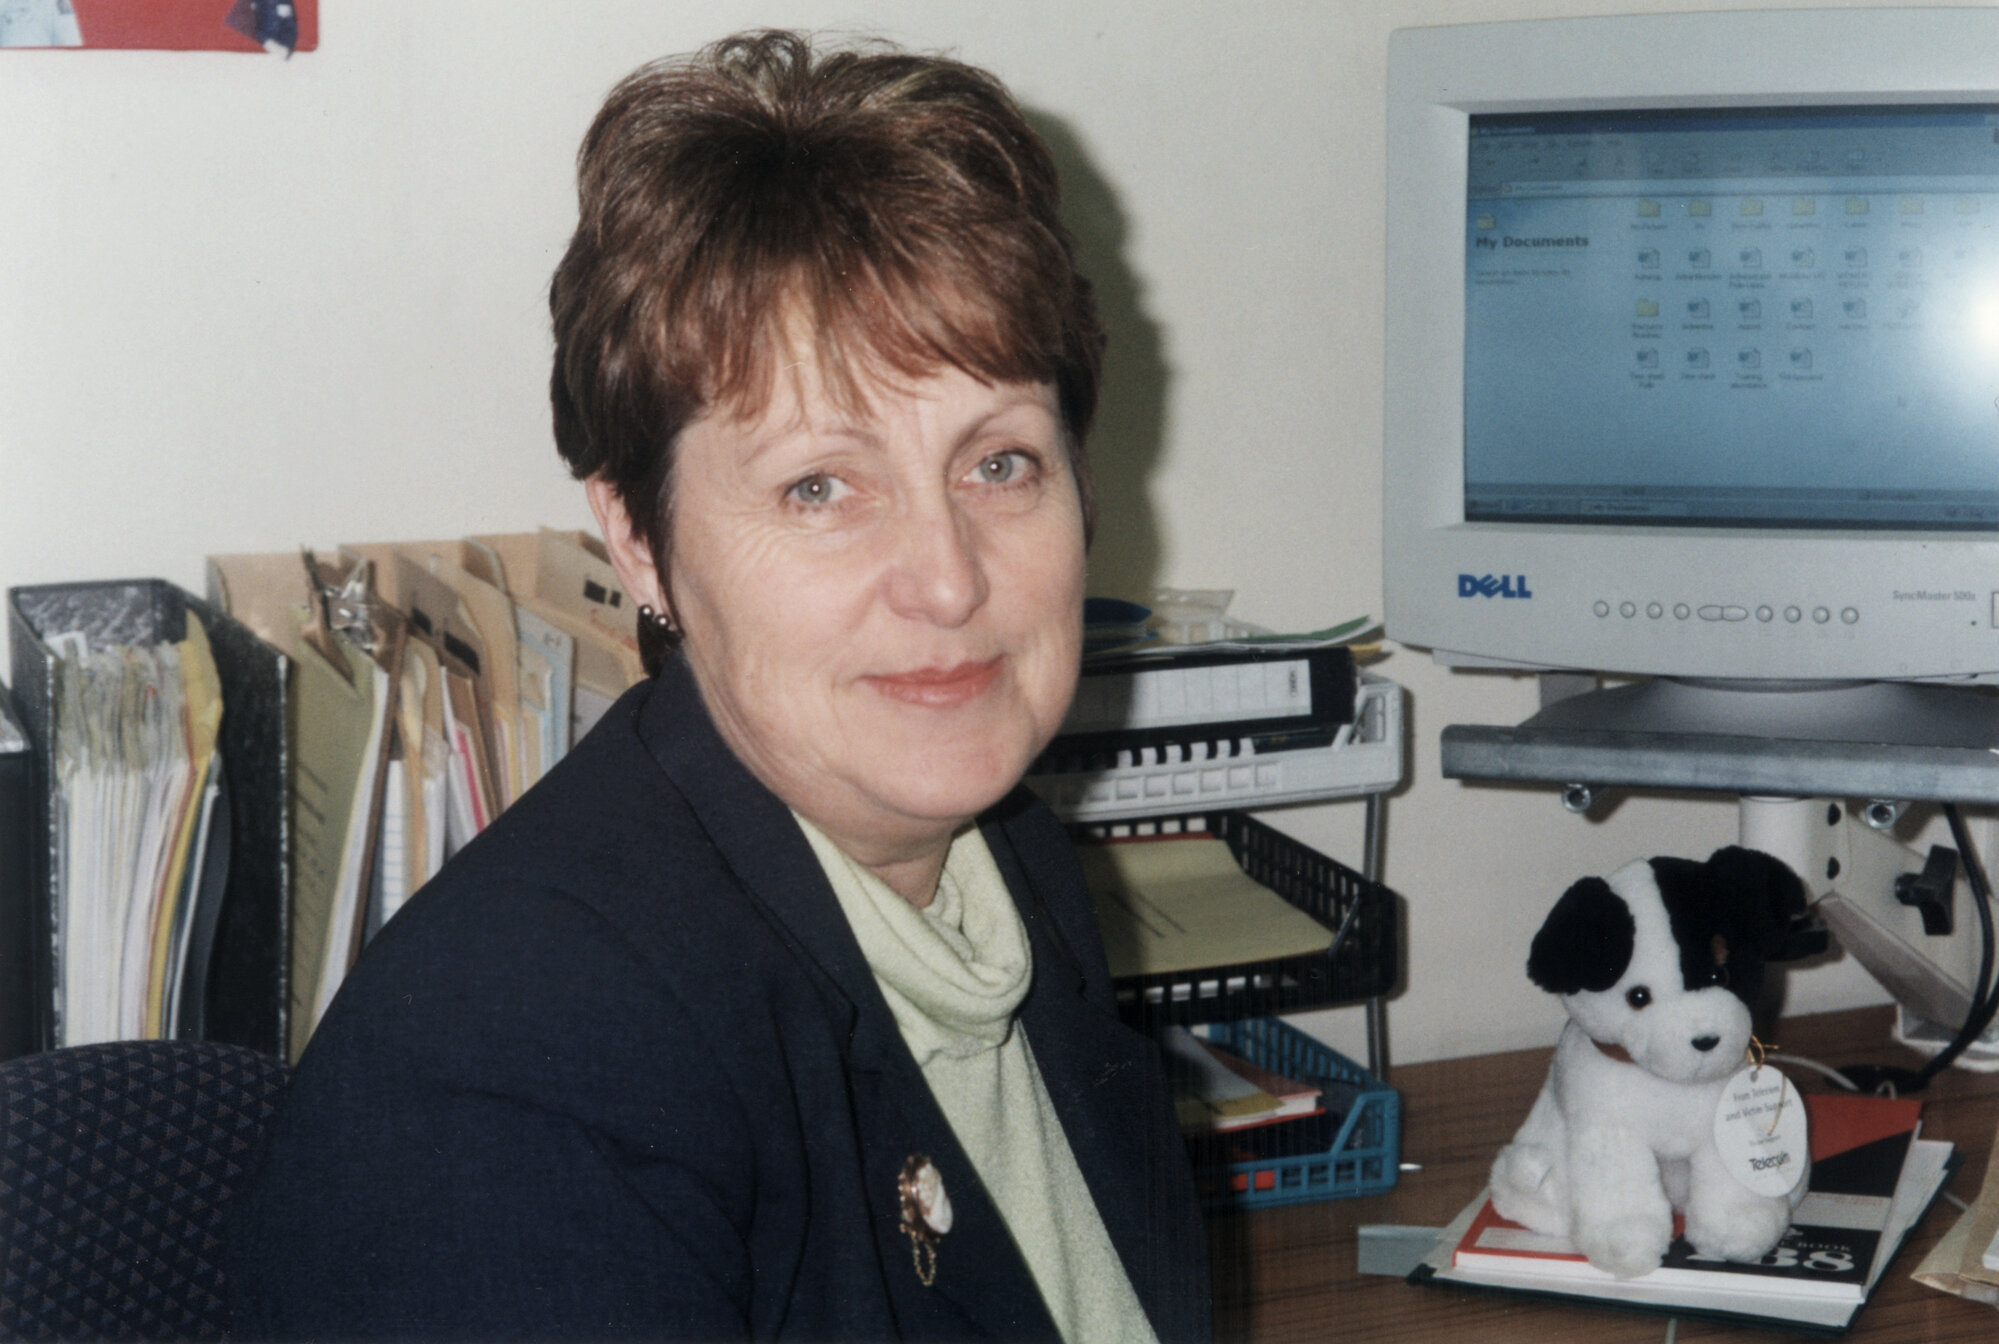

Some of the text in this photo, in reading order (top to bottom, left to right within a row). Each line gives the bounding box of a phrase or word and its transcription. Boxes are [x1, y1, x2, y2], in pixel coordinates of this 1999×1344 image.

[1475, 236, 1589, 250] My Documents
[1458, 574, 1532, 598] DELL
[1893, 590, 1951, 602] SyncMaster
[1734, 1085, 1780, 1102] From Telecom
[1726, 1111, 1740, 1121] and
[1742, 1105, 1763, 1118] Victim
[1797, 1241, 1850, 1252] BOOK
